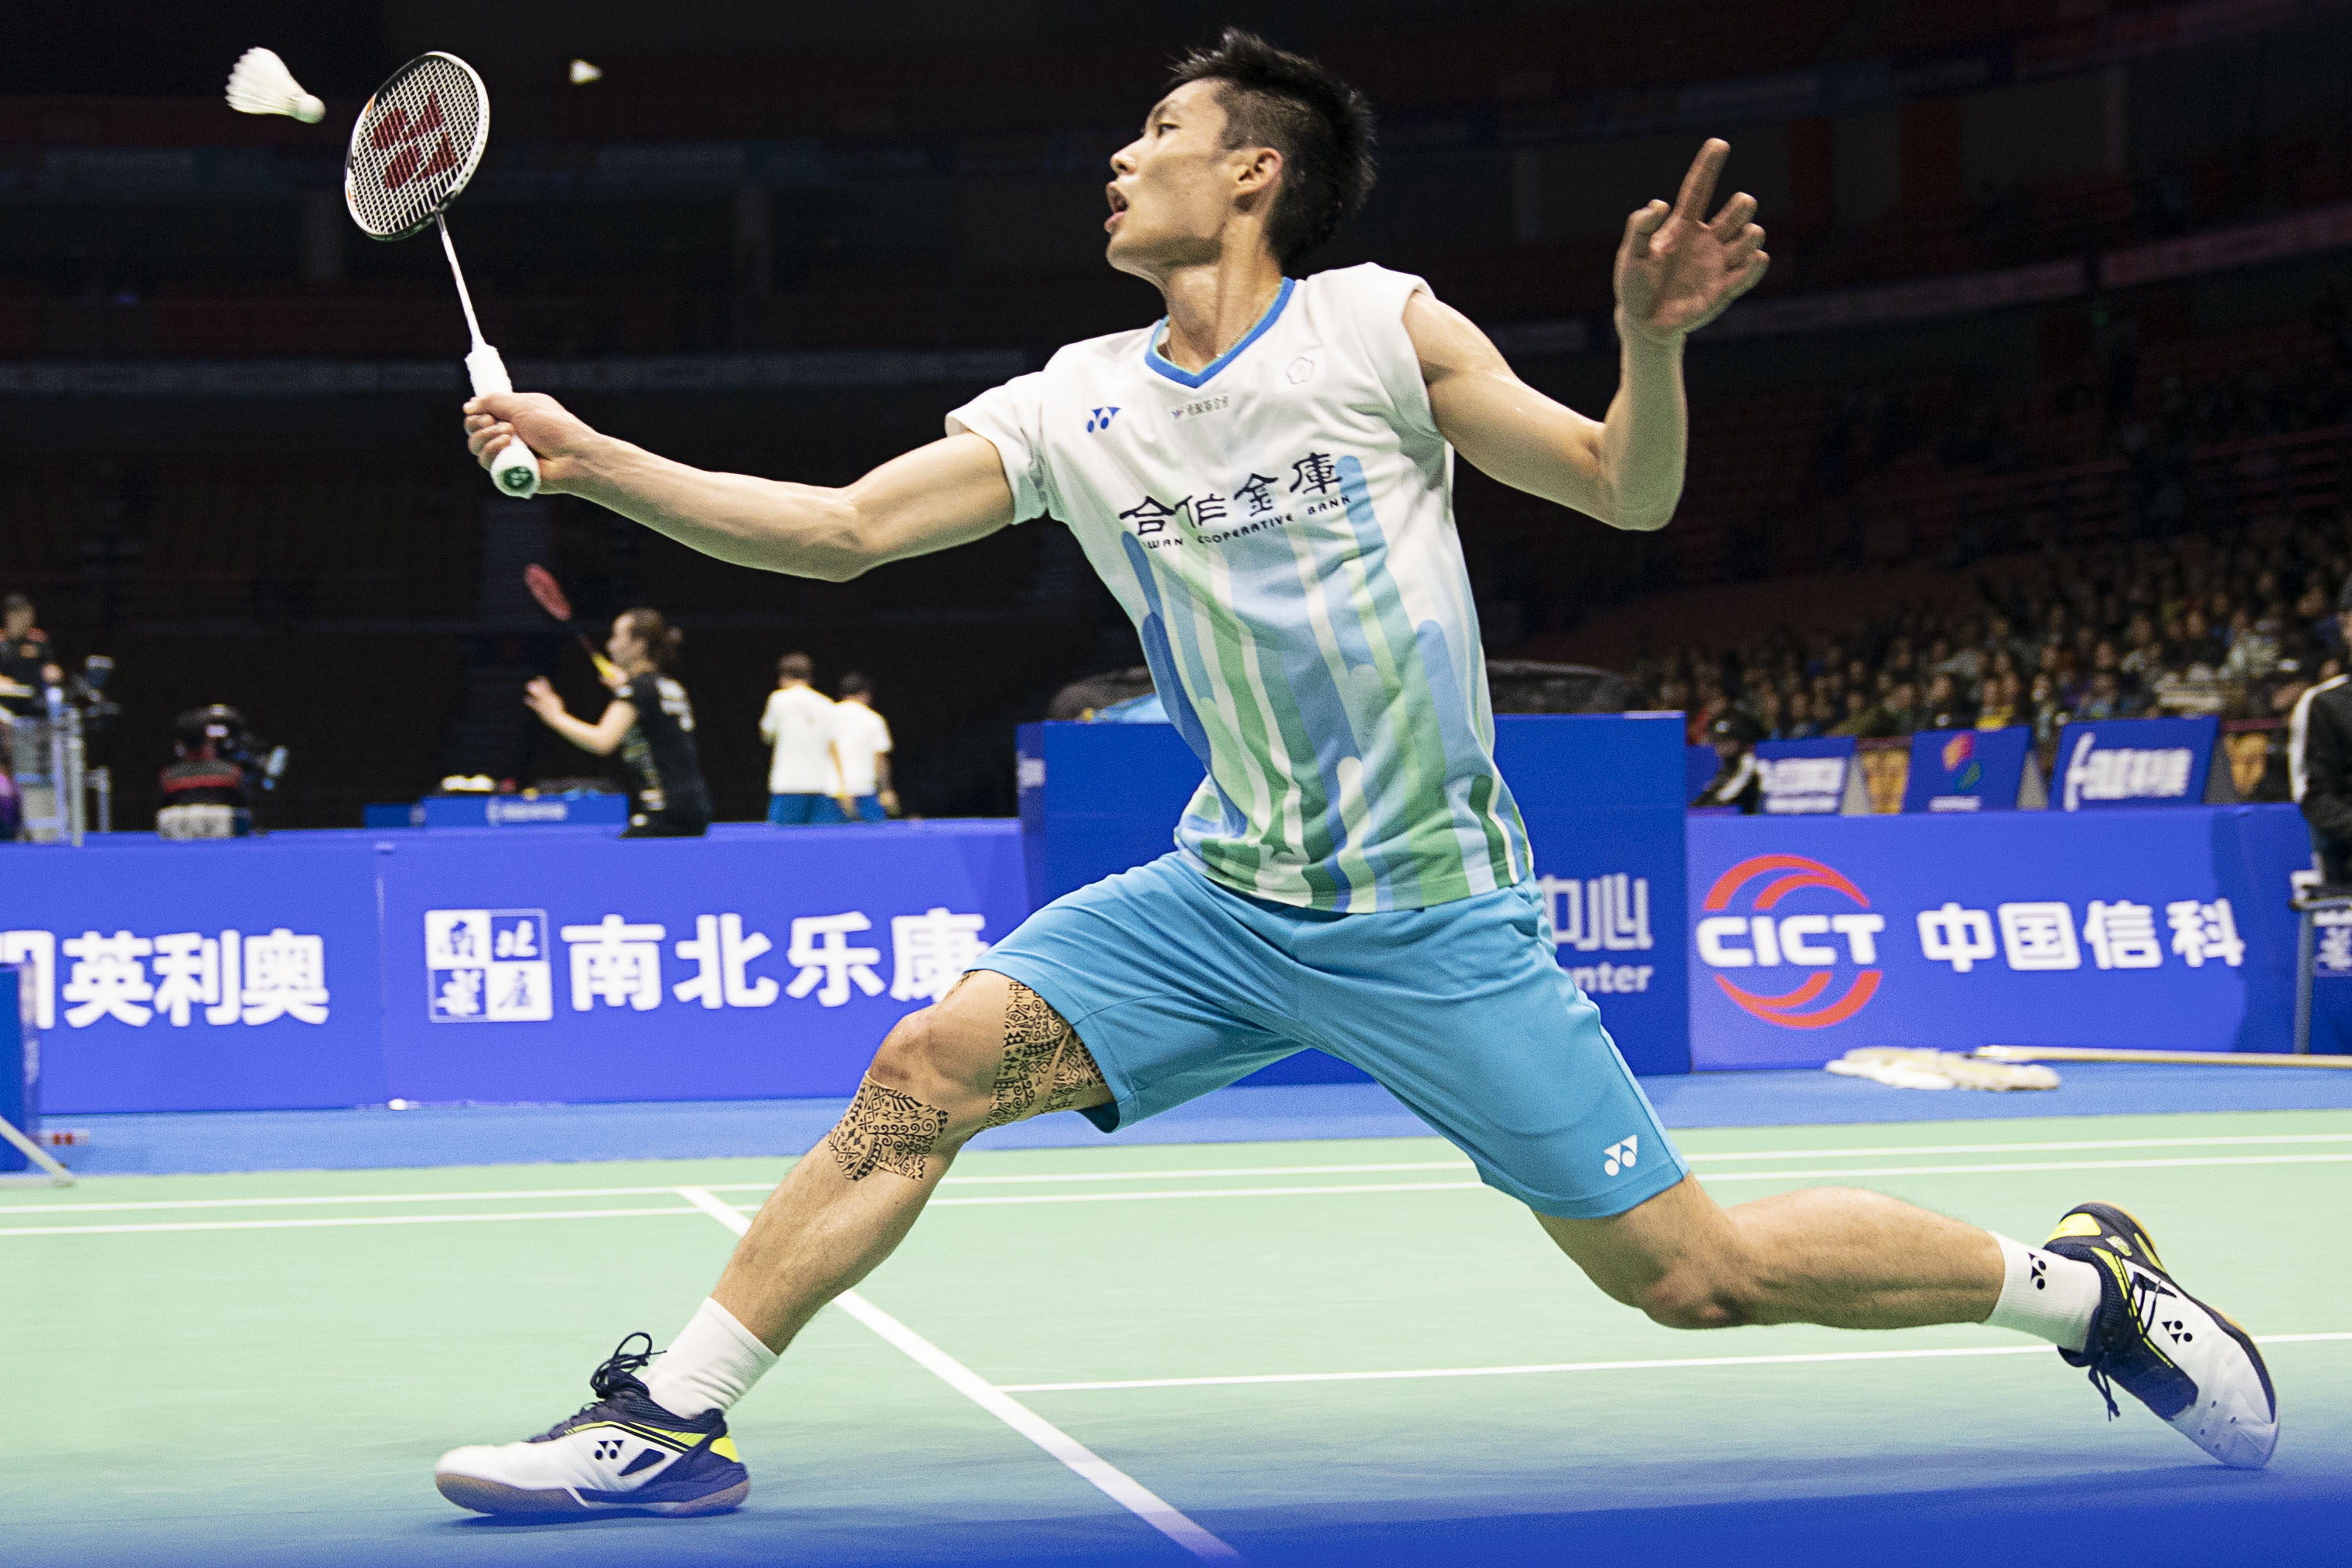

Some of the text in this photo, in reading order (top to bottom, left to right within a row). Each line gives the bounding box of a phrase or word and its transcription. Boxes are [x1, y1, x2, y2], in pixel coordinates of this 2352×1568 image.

[1197, 513, 1294, 544] COOPERATIVE
[1307, 496, 1350, 516] BANK
[561, 908, 989, 1011] 南北乐康
[1696, 914, 1885, 967] CICT
[1917, 898, 2245, 973] 中国信科
[1568, 962, 1655, 994] nter
